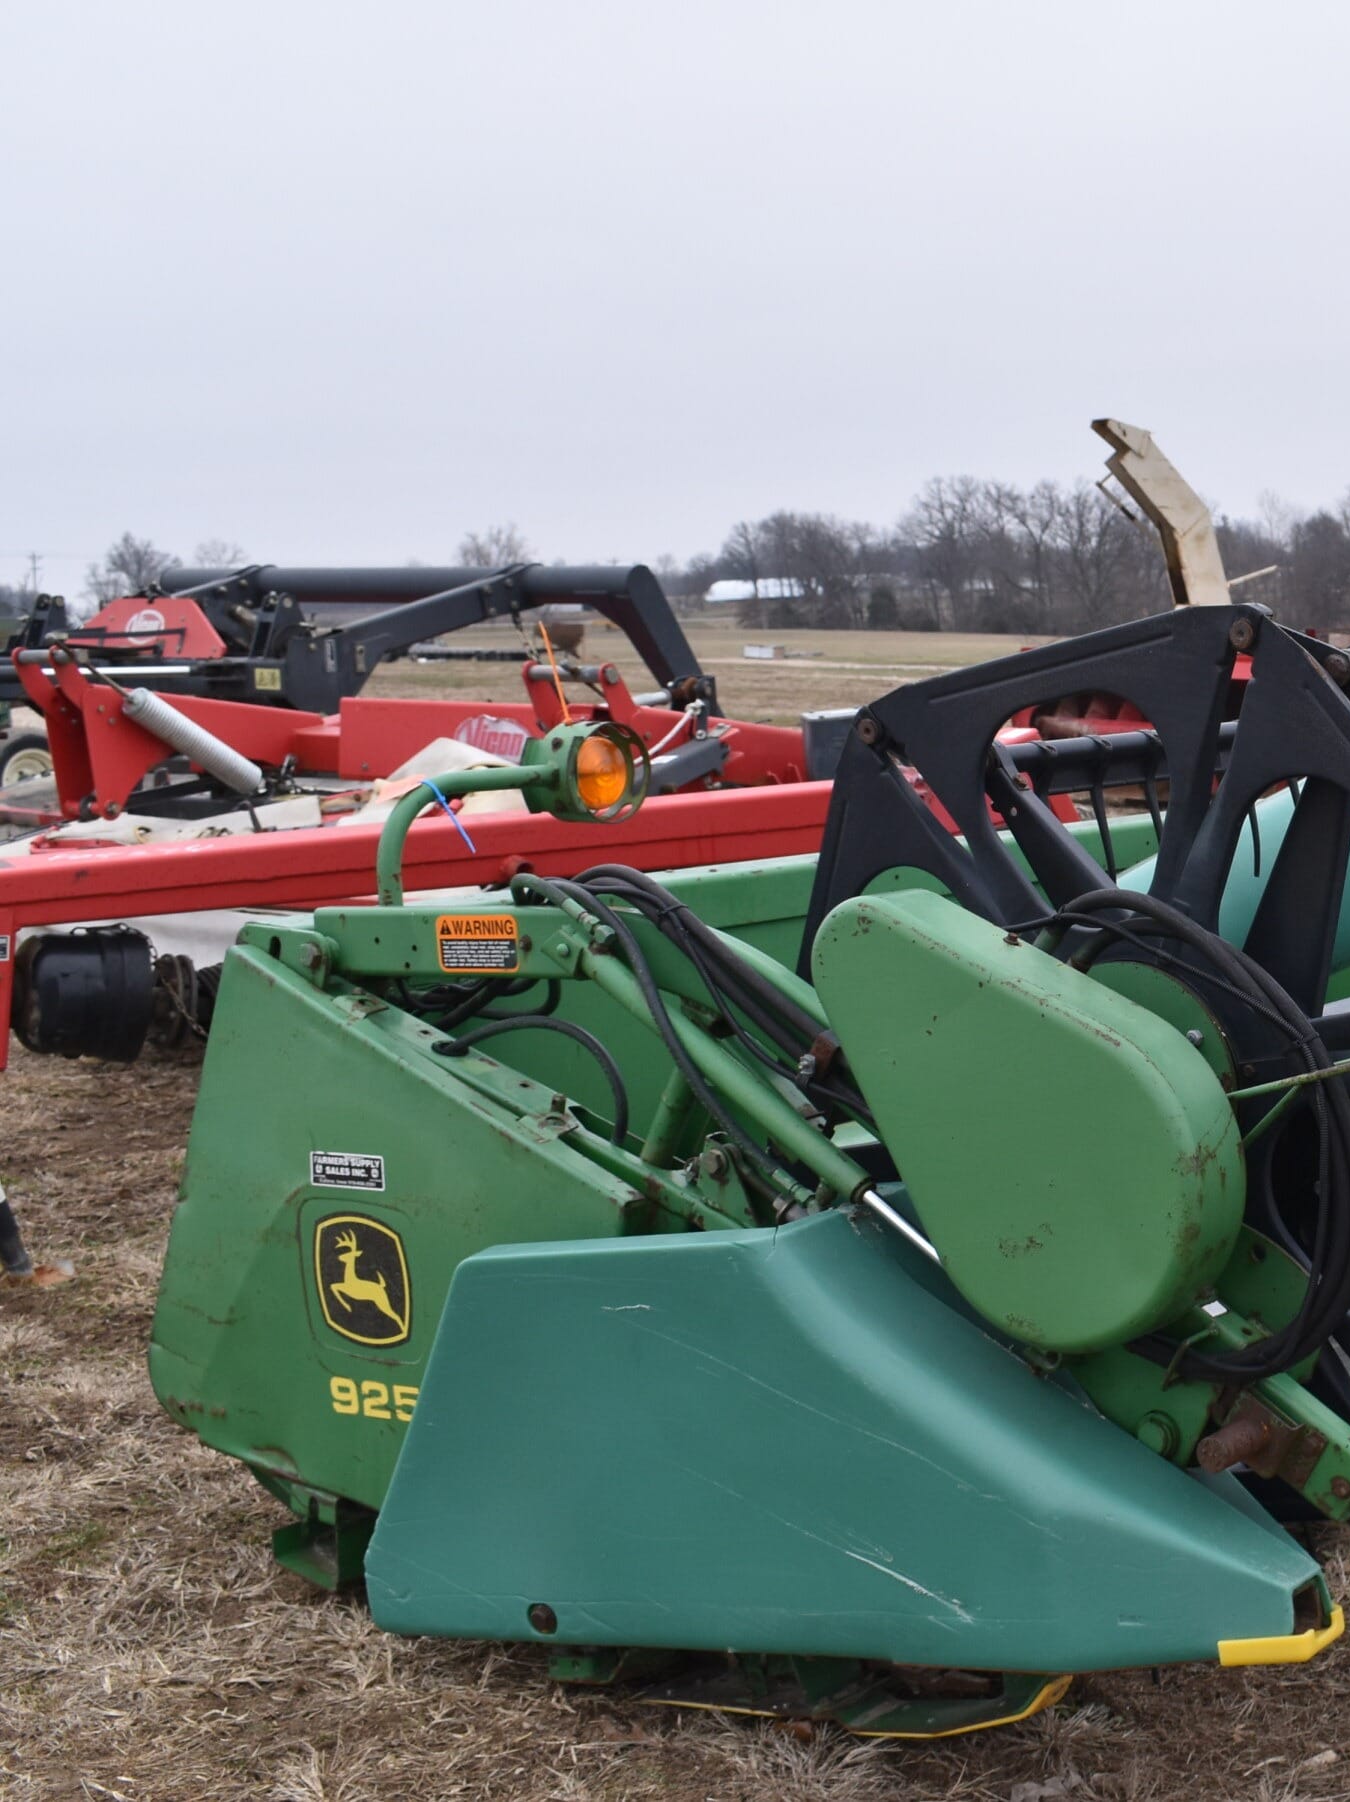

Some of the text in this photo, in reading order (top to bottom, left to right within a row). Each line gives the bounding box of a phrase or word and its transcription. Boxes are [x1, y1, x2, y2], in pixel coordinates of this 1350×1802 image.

[451, 919, 514, 935] WARNING
[350, 1157, 380, 1168] SUPPLY
[325, 1166, 368, 1177] SALES INC.
[330, 1376, 420, 1422] 925
